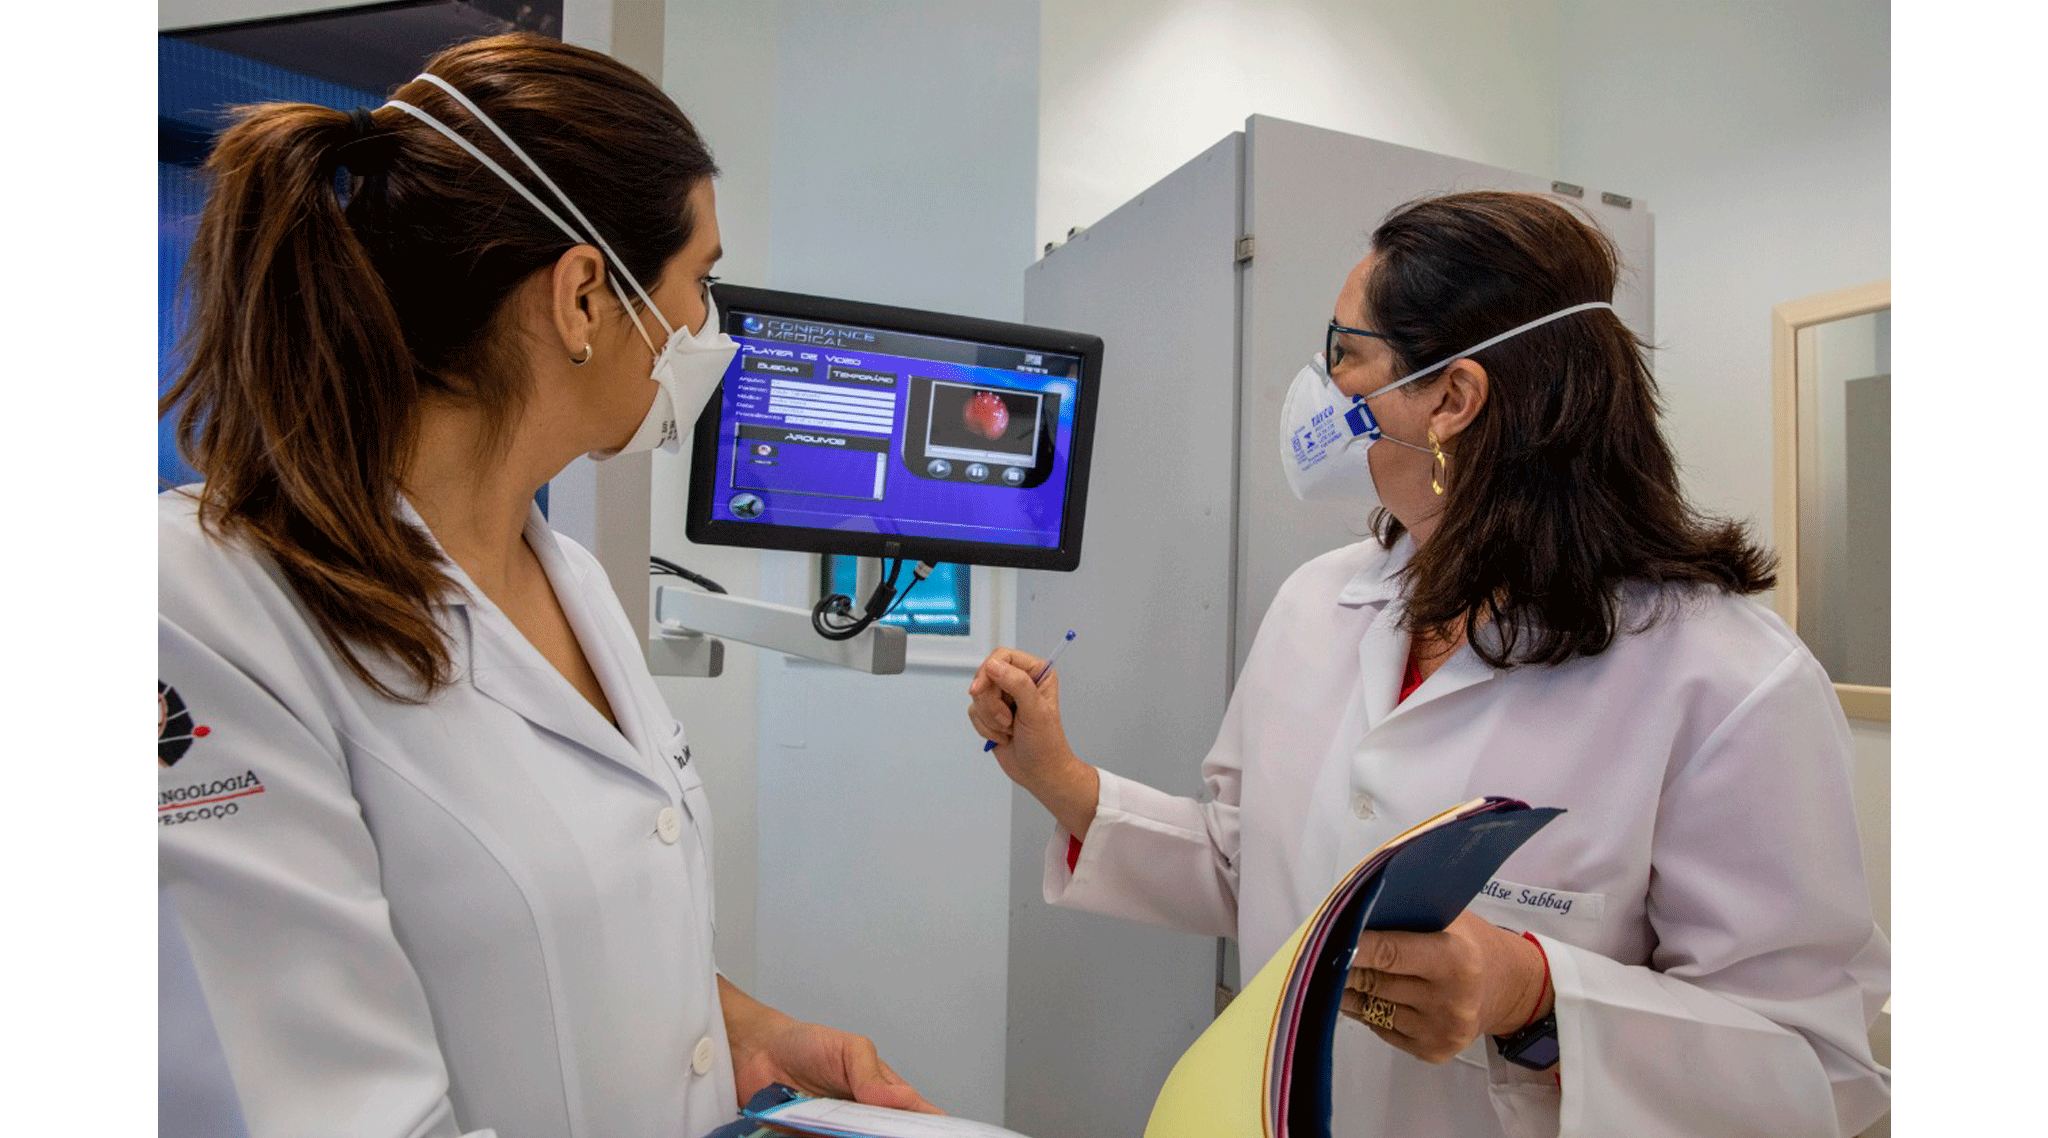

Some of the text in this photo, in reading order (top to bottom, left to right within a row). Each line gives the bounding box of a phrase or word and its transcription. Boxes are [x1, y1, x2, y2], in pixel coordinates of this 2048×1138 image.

[767, 320, 875, 342] CONFIANCE
[767, 330, 847, 347] MEDICAL
[742, 345, 794, 357] PLAYER
[757, 362, 799, 373] BUSCAR
[784, 433, 846, 446] ARQUIVOS
[1517, 889, 1573, 915] Sabbag
